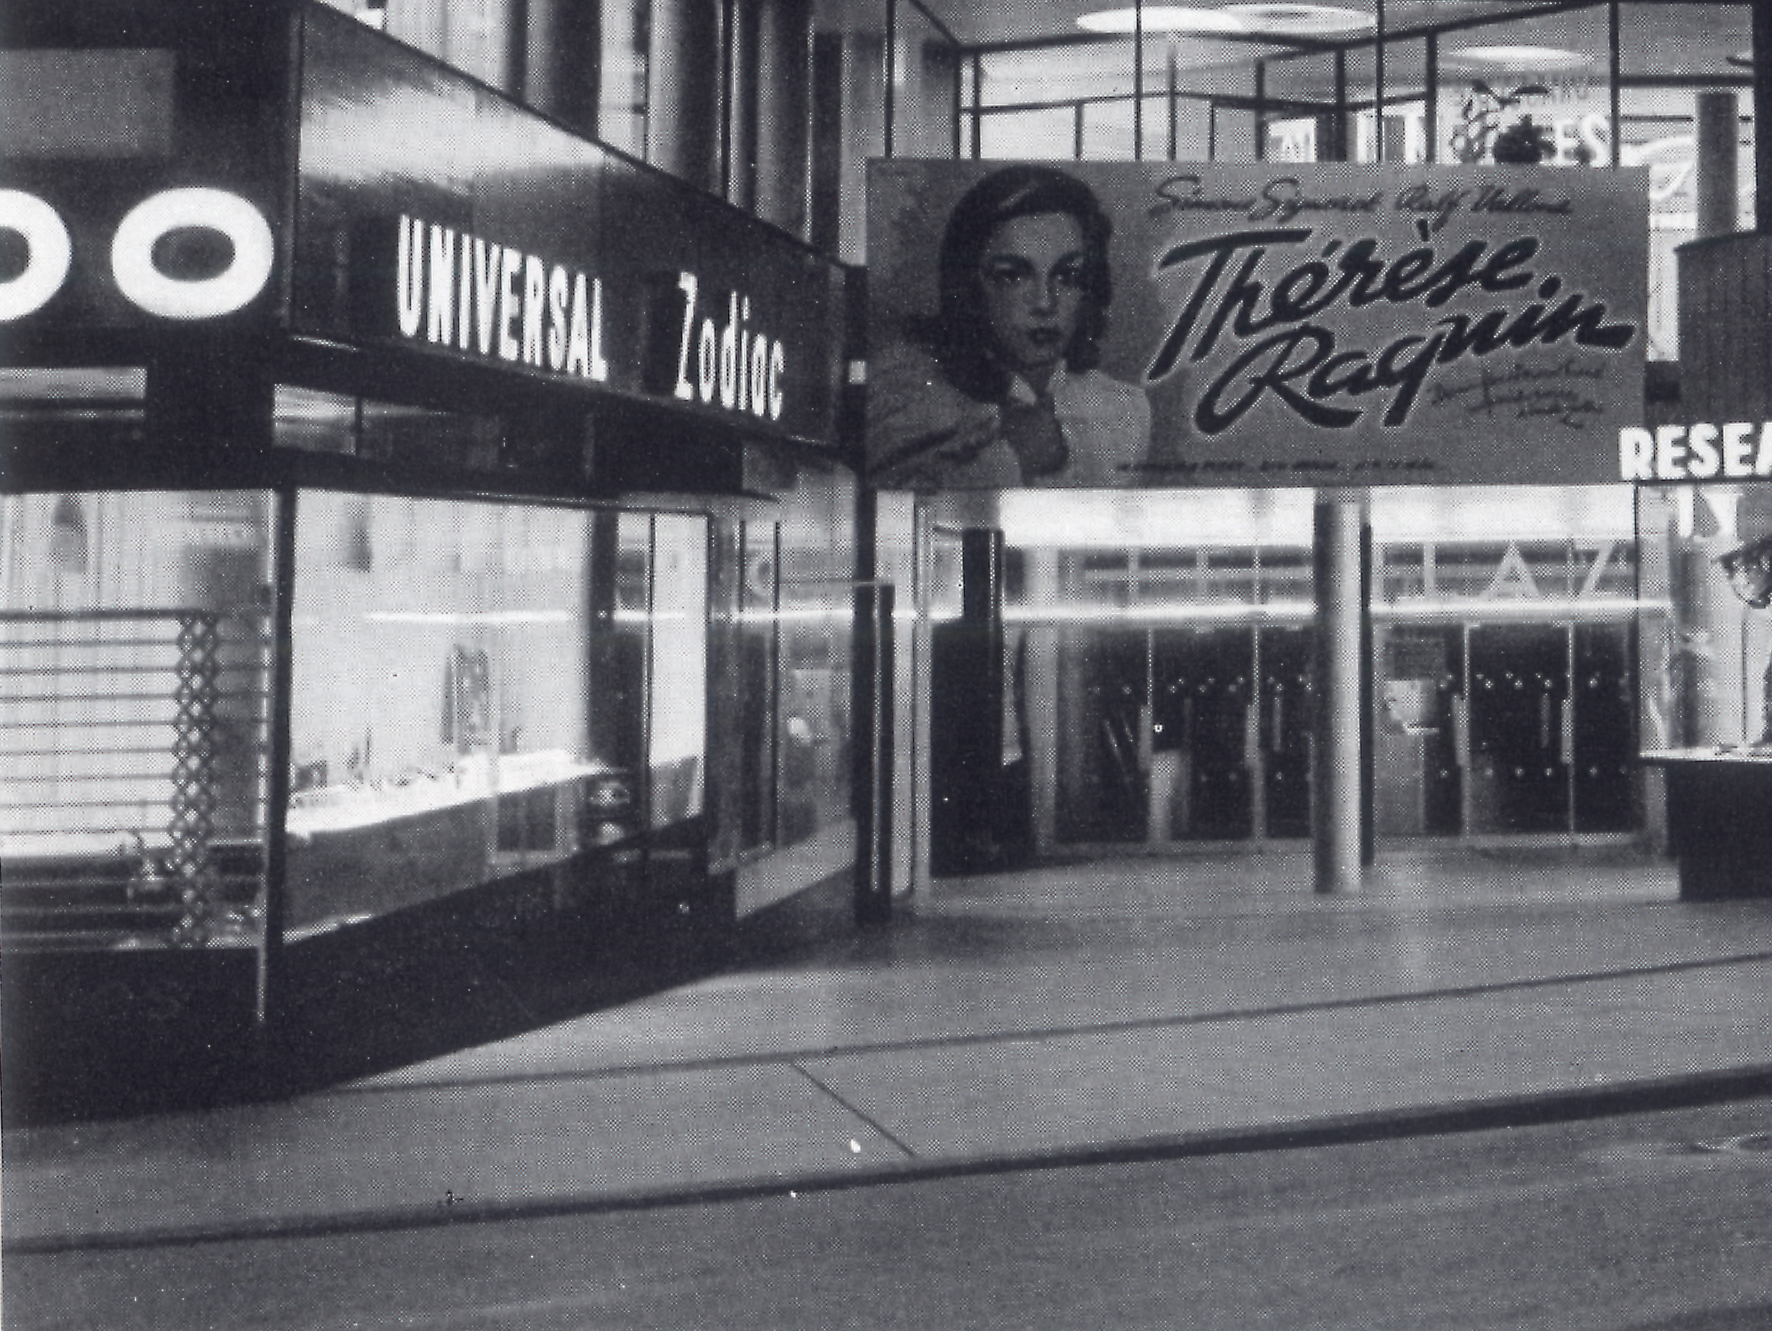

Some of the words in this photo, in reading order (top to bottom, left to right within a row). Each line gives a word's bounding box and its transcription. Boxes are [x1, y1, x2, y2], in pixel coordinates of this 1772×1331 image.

[398, 214, 608, 381] UNIVERSAL
[675, 272, 784, 421] Zodiac
[1147, 218, 1541, 380] Thérèse
[1194, 276, 1636, 435] Raquin
